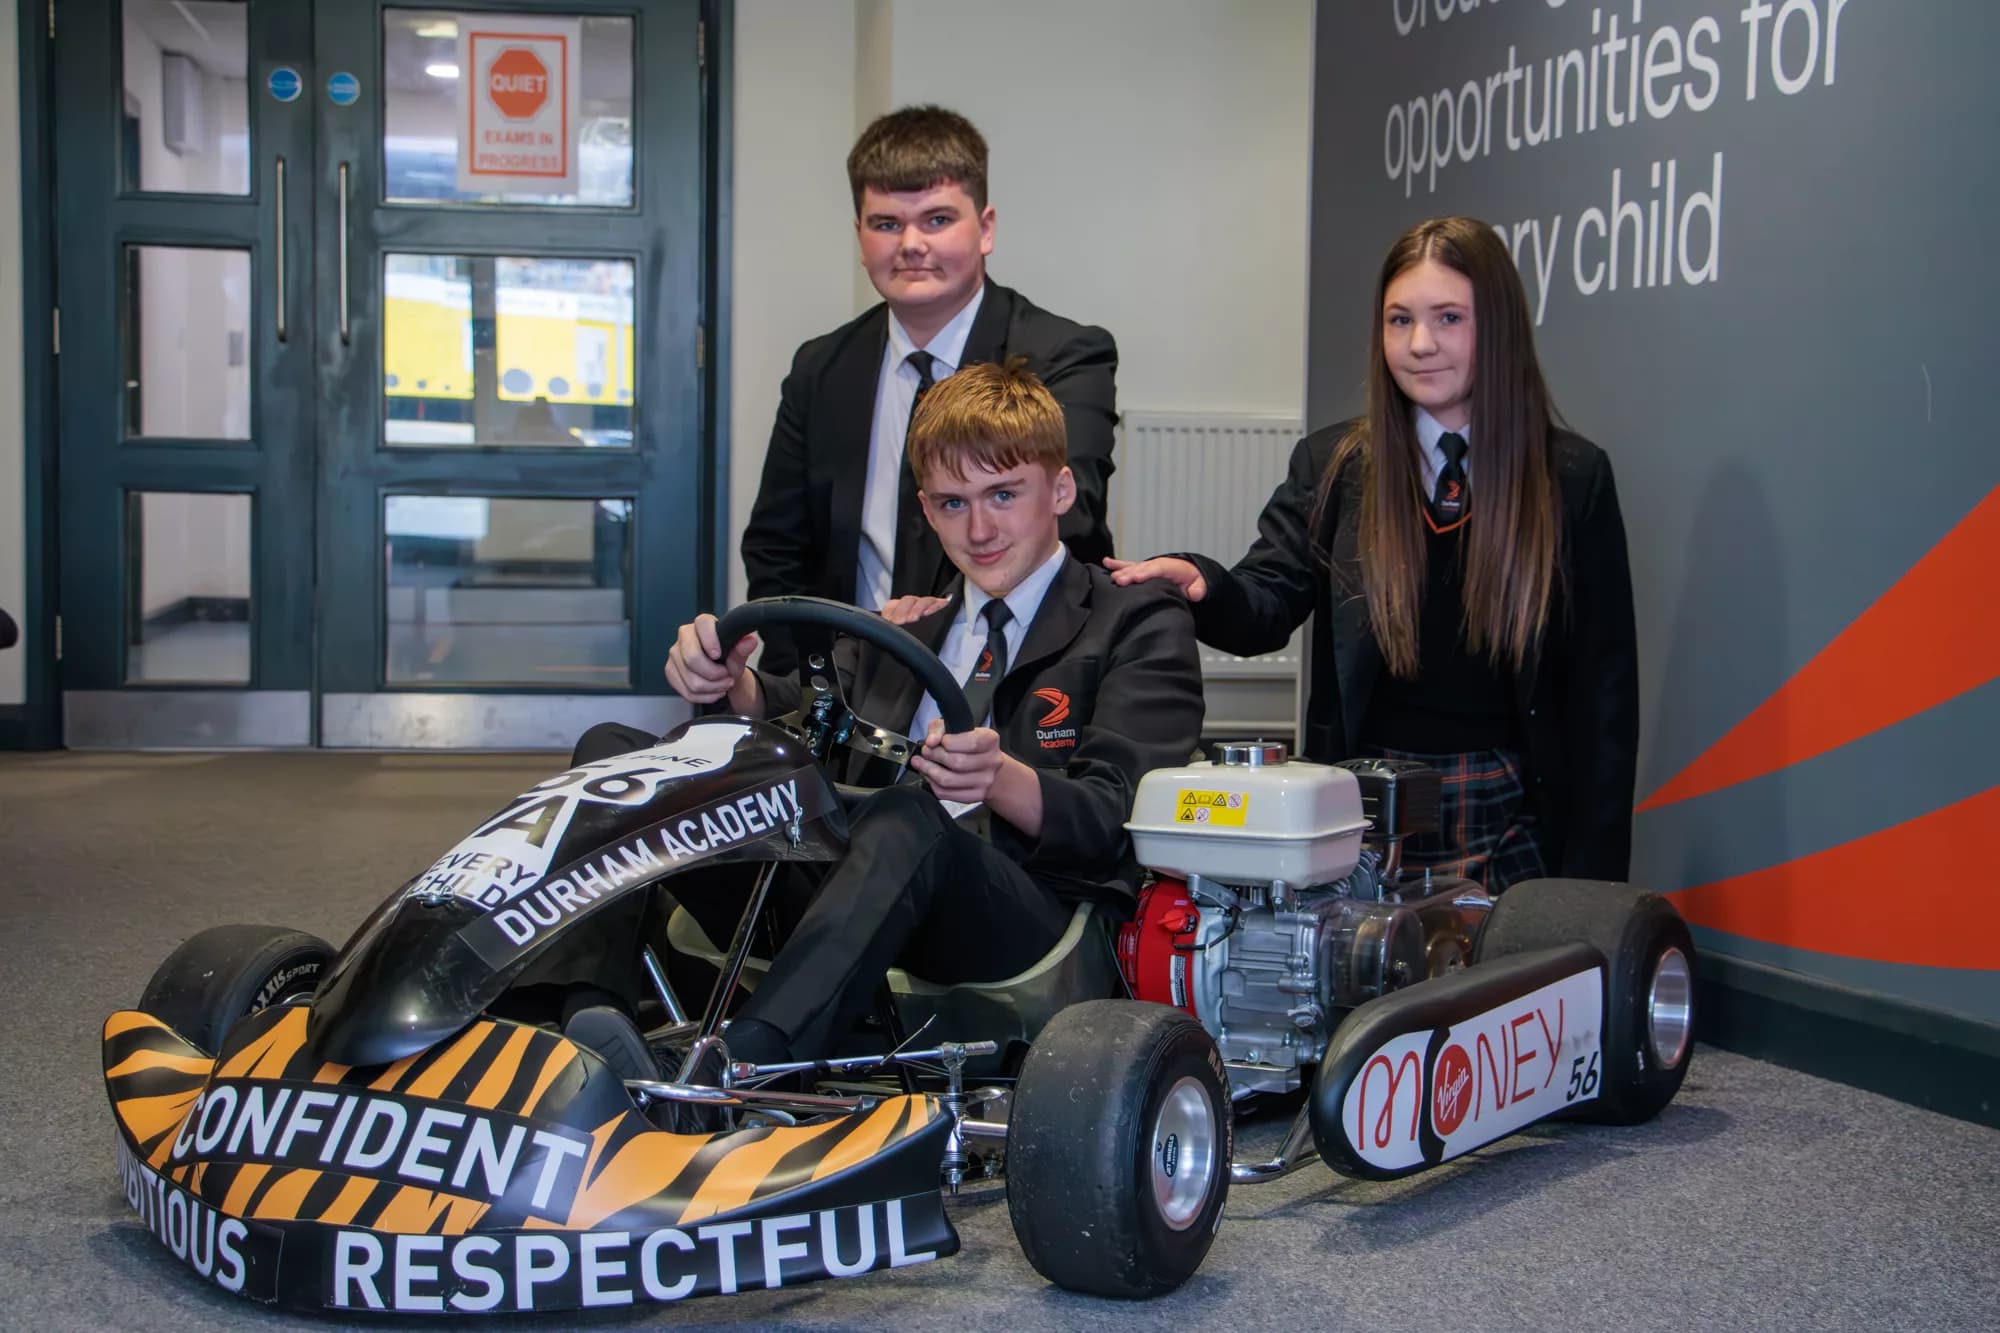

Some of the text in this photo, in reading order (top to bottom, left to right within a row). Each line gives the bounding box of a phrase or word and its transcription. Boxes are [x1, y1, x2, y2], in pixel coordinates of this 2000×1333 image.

[490, 73, 545, 93] QUIET
[1385, 0, 1848, 197] opportunities for
[484, 129, 554, 145] EXAMS IN
[1573, 152, 1723, 296] child
[1036, 728, 1075, 739] Durham
[1039, 739, 1075, 748] Academy
[429, 852, 538, 887] EVERY
[493, 780, 800, 947] DURHAM ACADEMY
[252, 963, 320, 1013] XXIS SPORT
[1437, 1060, 1470, 1122] Virgin
[1566, 1051, 1600, 1102] 56
[173, 1085, 587, 1210] CONFIDENT
[115, 1130, 249, 1294] BITIOUS
[333, 1200, 937, 1312] RESPECTFUL
